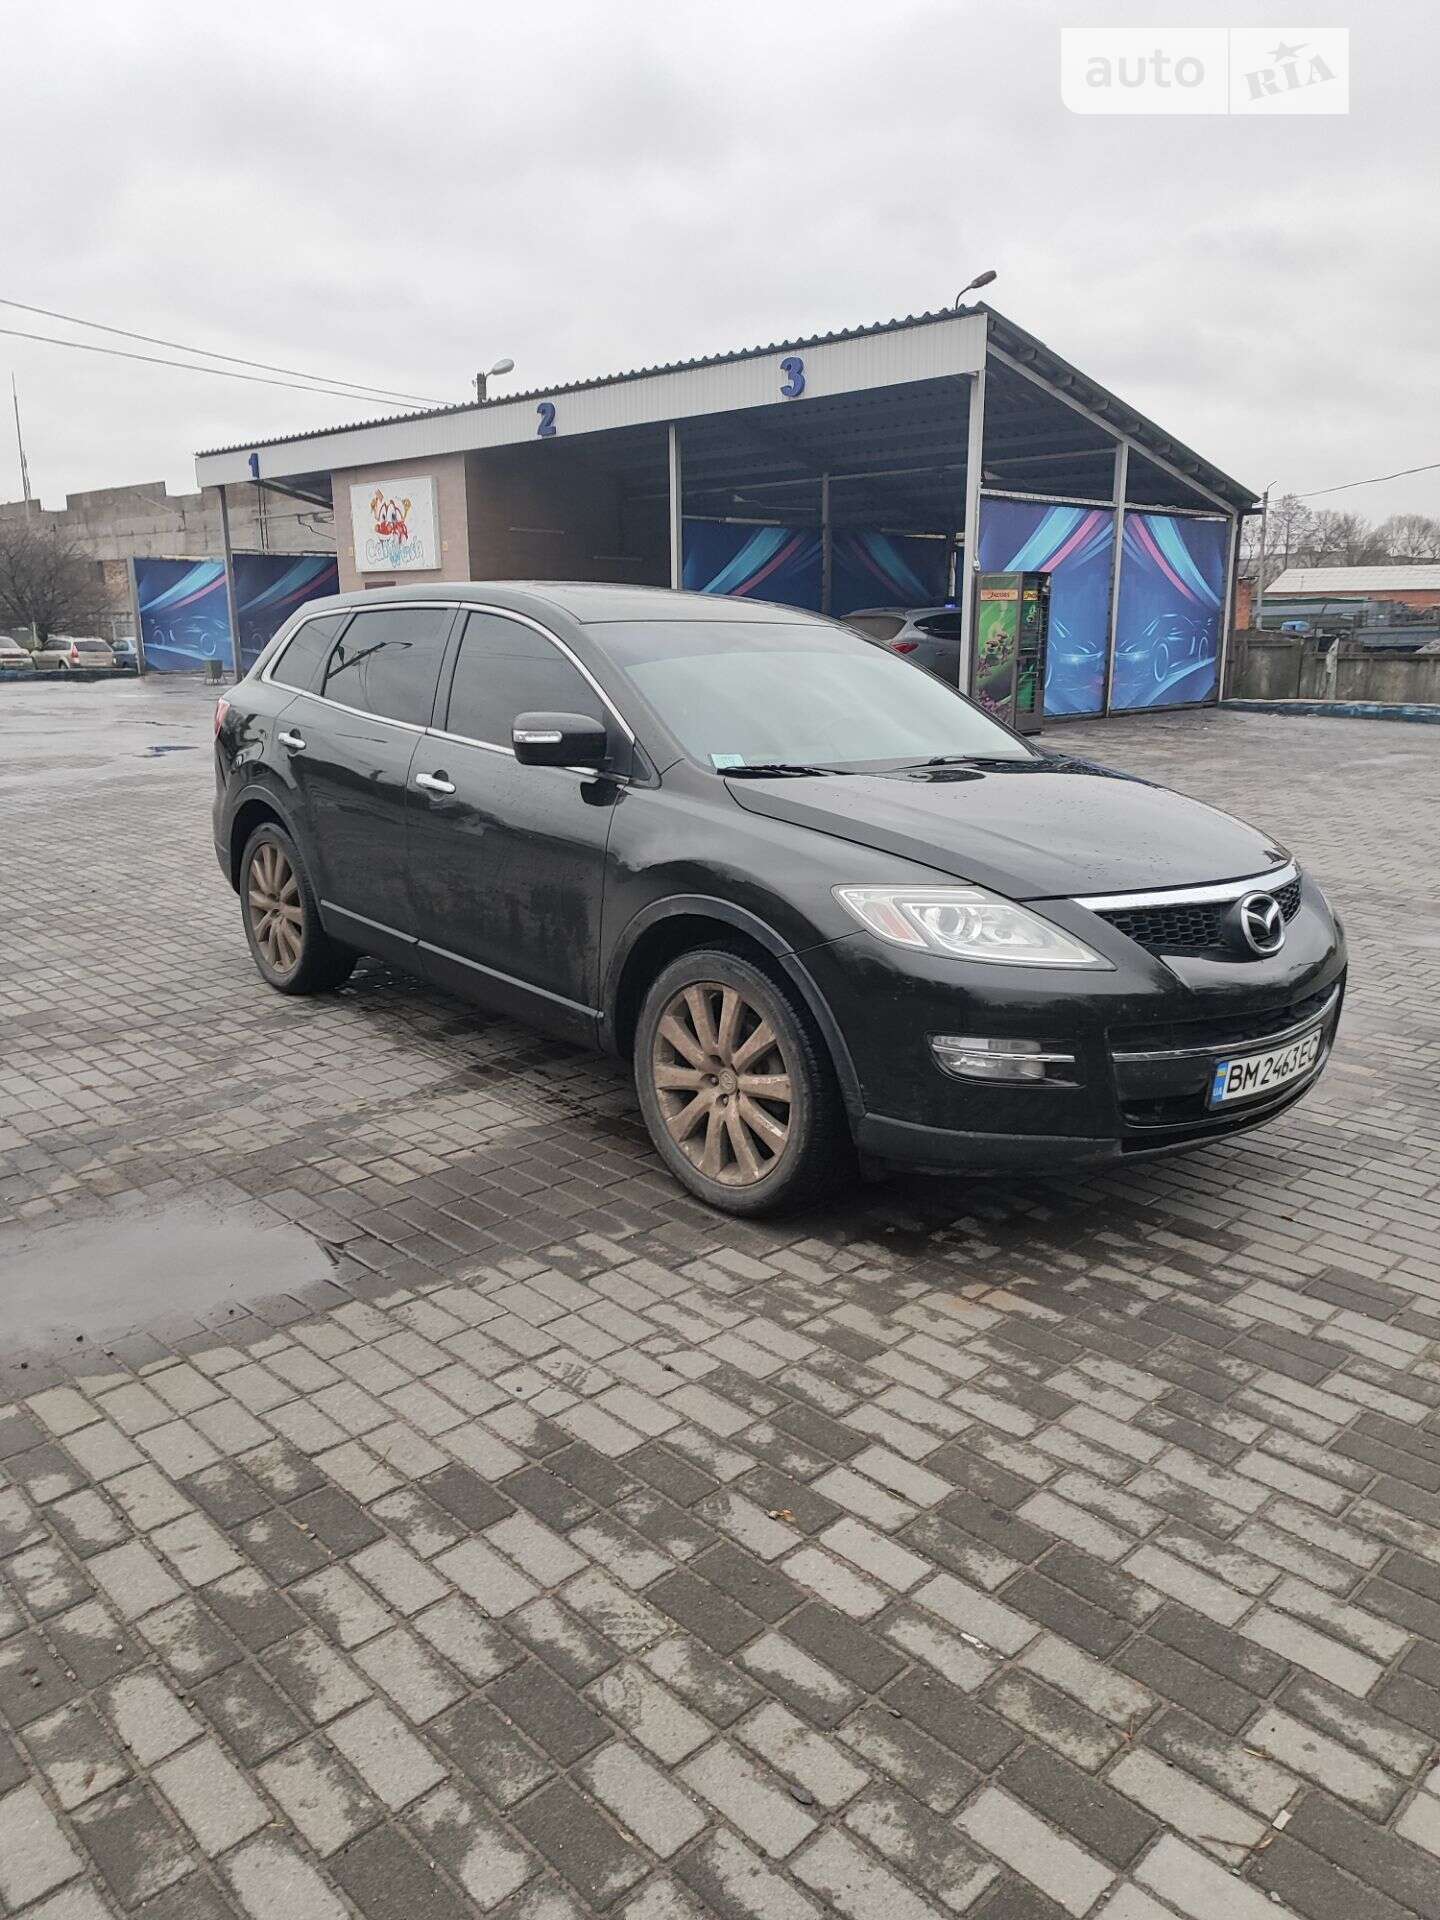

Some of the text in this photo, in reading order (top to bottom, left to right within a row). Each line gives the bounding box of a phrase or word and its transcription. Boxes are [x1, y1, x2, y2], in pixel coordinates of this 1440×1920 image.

[780, 357, 807, 398] 3
[537, 402, 557, 437] 2
[248, 453, 261, 478] 1
